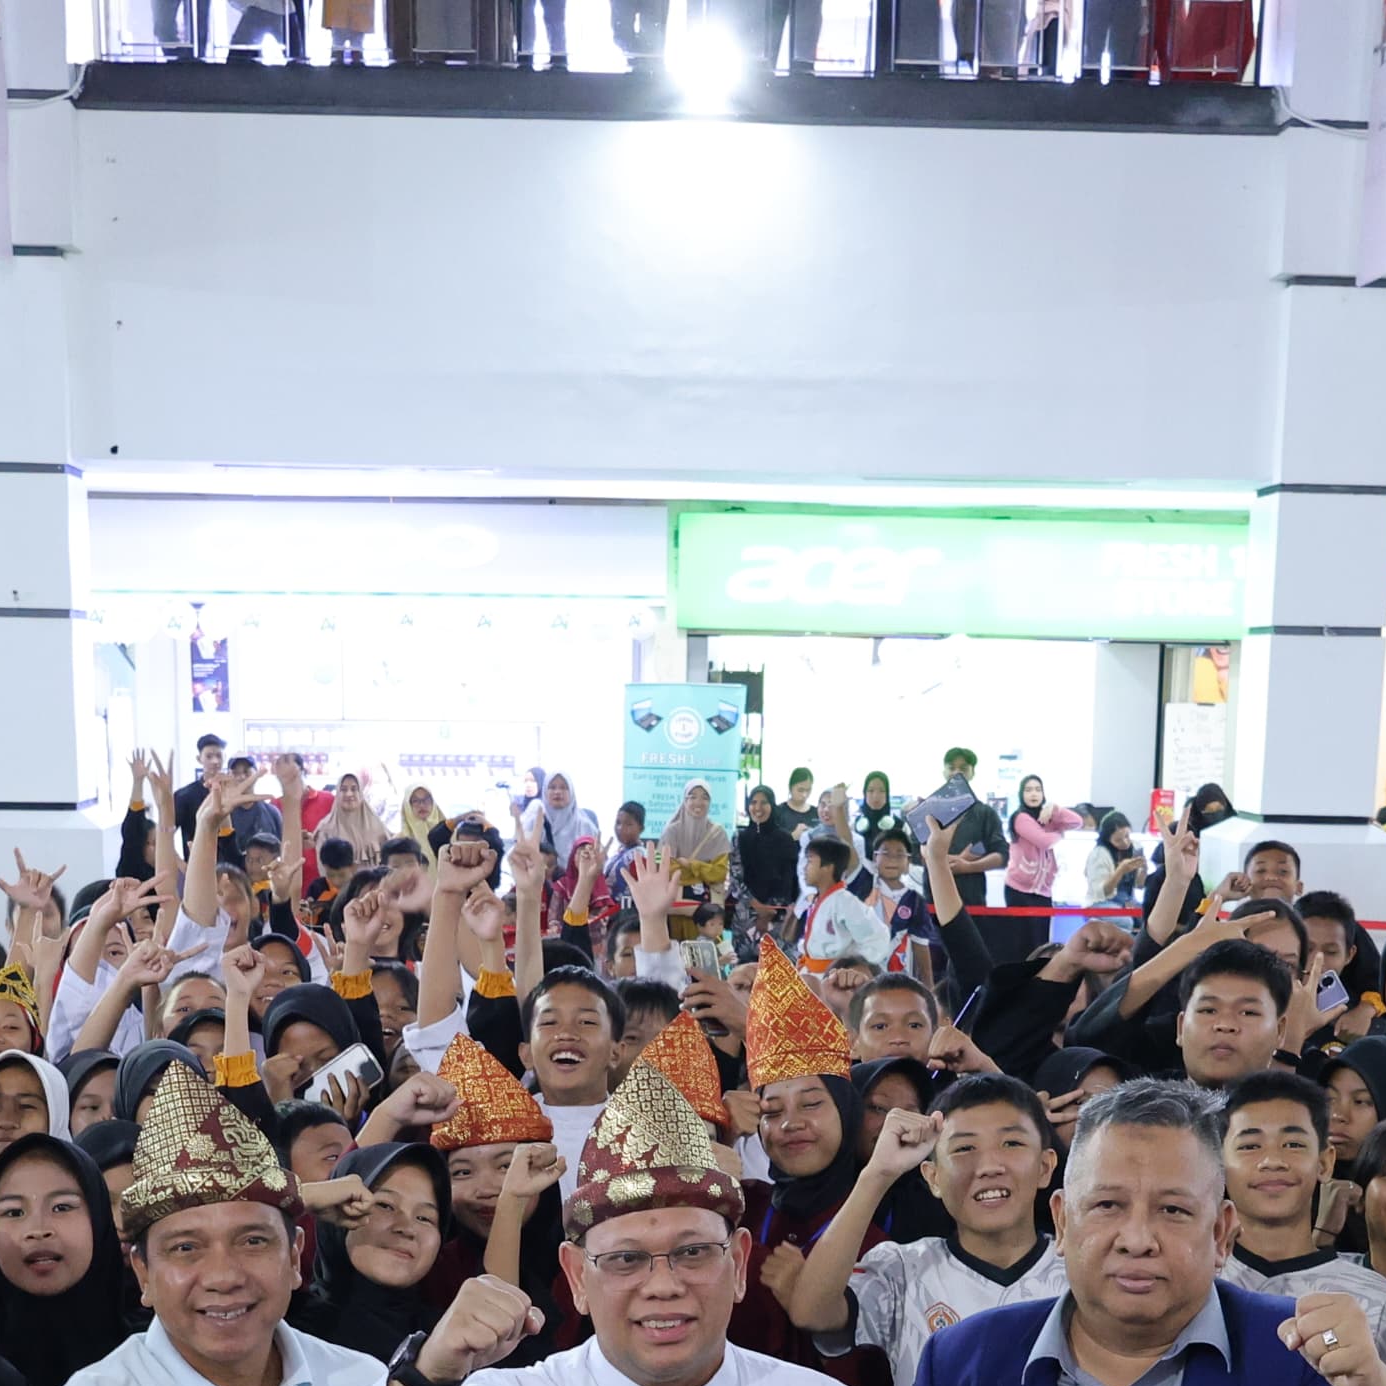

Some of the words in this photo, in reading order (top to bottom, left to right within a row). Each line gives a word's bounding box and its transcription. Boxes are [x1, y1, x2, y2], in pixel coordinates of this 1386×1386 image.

[725, 543, 943, 605] acer
[1101, 542, 1220, 578] FRESH
[641, 751, 686, 765] FRESH
